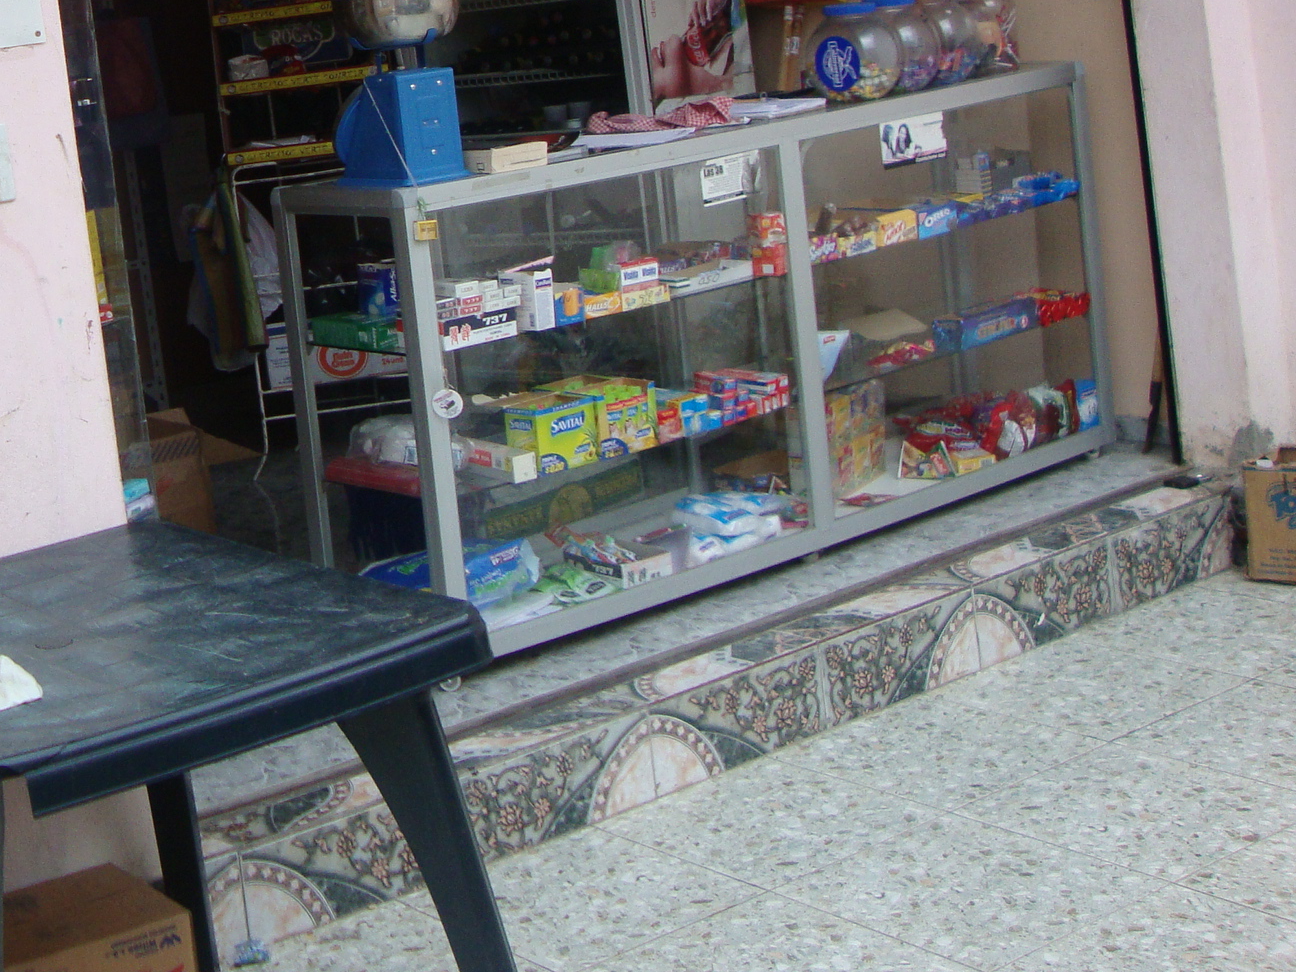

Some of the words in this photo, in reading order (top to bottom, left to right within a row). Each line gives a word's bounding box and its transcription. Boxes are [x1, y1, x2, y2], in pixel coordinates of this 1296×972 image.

[923, 208, 951, 228] OREO
[585, 300, 608, 313] HALLS
[482, 313, 508, 326] 737
[551, 415, 585, 434] SAVITAL
